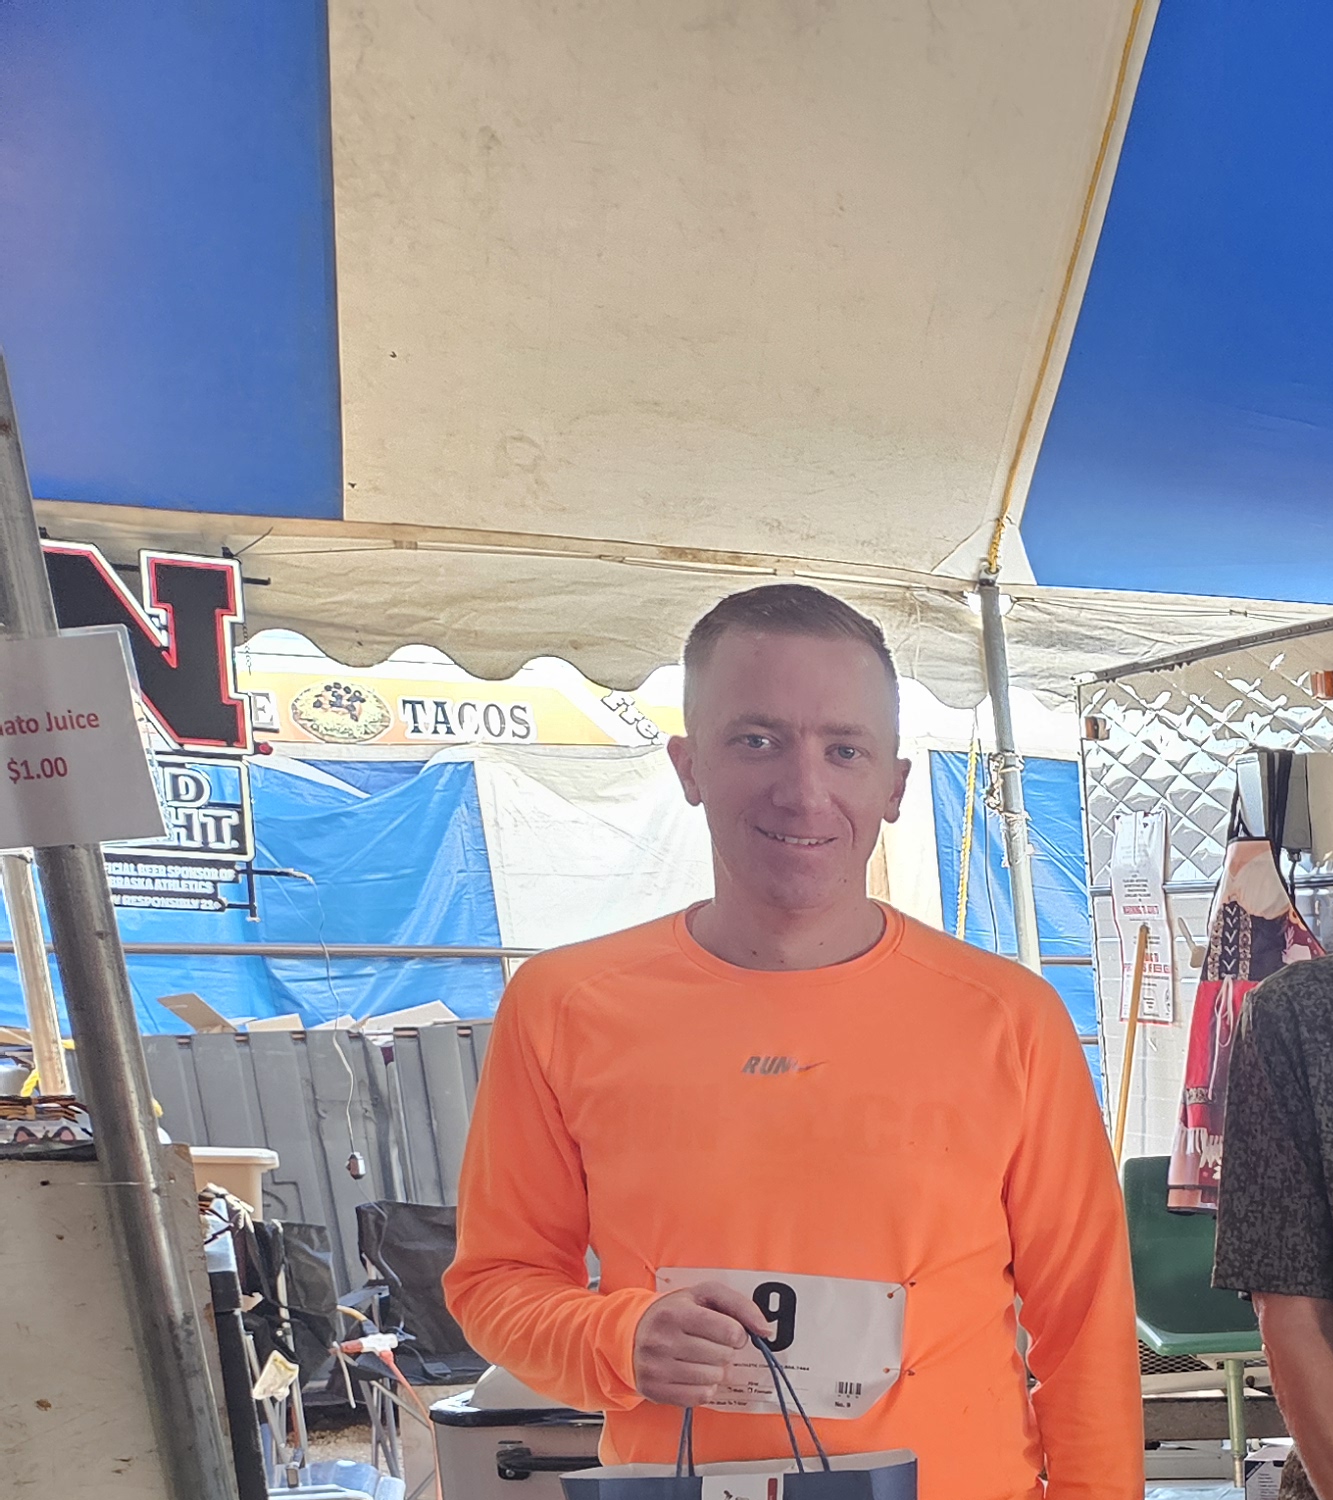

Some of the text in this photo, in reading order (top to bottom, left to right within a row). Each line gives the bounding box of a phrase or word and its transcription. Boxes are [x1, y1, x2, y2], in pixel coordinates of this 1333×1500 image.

[0, 709, 100, 736] ato Juice
[402, 698, 532, 740] TACOS
[7, 756, 68, 784] $1.00
[742, 1056, 791, 1075] RUN
[751, 1282, 797, 1352] 9
